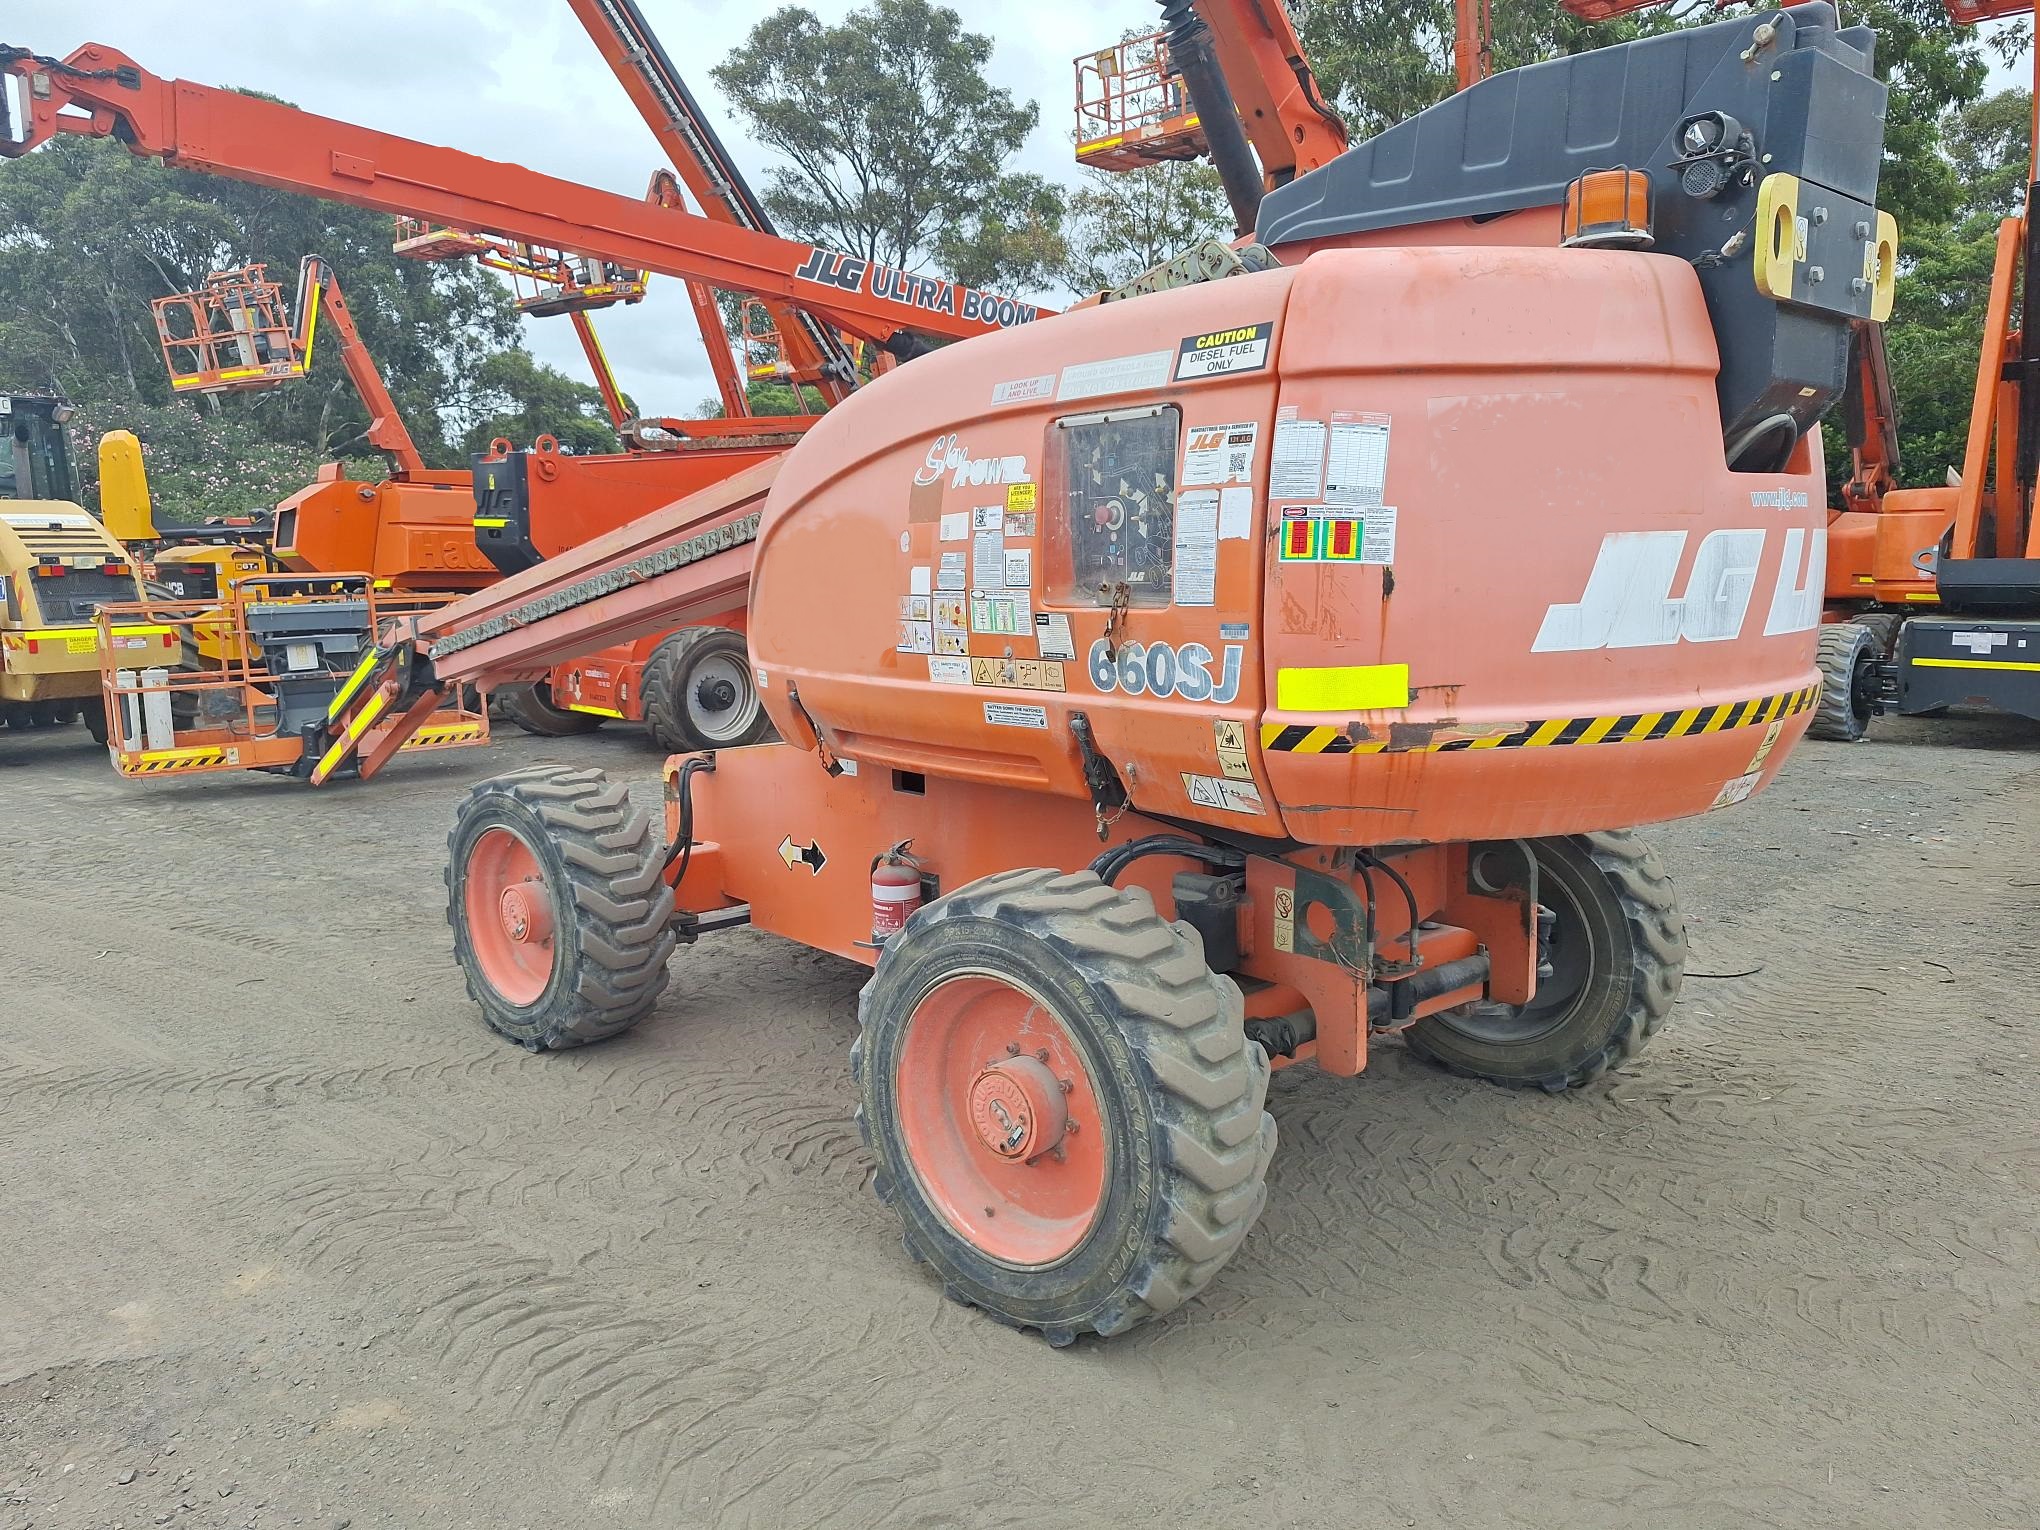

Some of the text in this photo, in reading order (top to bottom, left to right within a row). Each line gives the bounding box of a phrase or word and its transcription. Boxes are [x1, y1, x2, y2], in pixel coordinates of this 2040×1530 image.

[794, 248, 1038, 327] JLG ULTRA BOOM
[1196, 327, 1257, 349] CAUTION
[1190, 343, 1256, 364] DIESEL FUEL
[264, 364, 290, 376] JLG
[1207, 359, 1233, 372] ONLY
[1007, 387, 1038, 398] AND LIVE
[1009, 379, 1039, 391] LOOK UP
[1188, 433, 1225, 450] JLG
[1751, 487, 1808, 511] www.jlg.com
[1127, 572, 1145, 582] JLG
[1530, 529, 1766, 652] JLG
[1088, 638, 1243, 703] 660SJ
